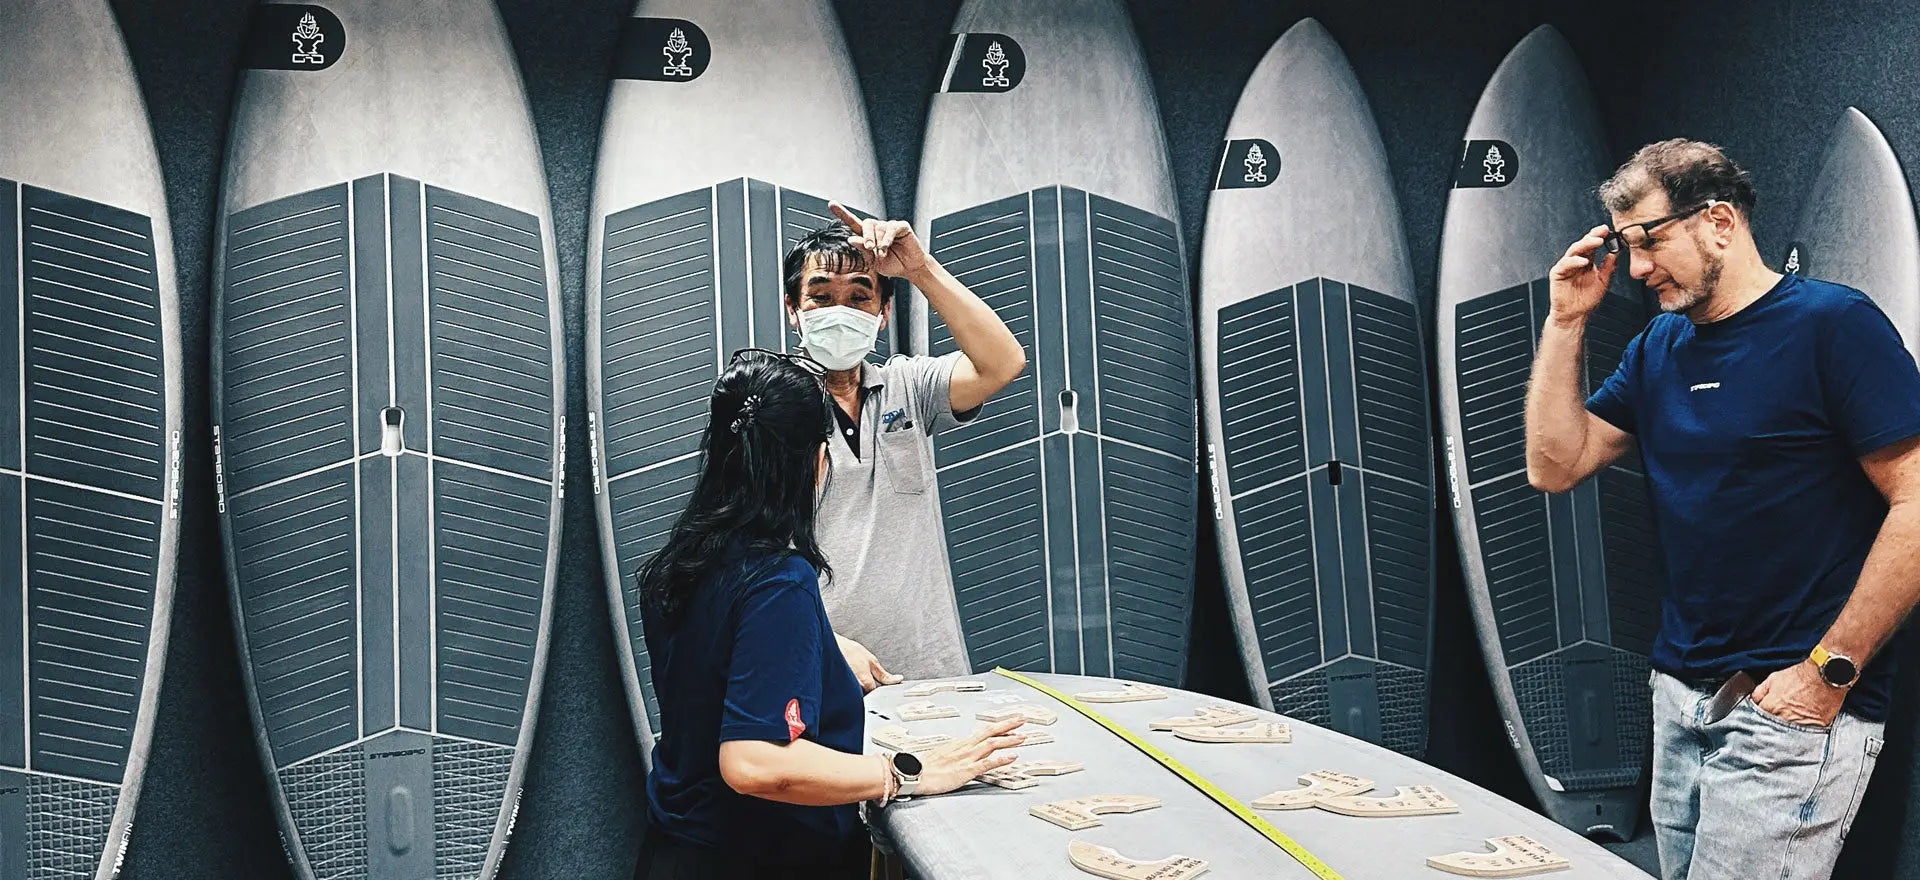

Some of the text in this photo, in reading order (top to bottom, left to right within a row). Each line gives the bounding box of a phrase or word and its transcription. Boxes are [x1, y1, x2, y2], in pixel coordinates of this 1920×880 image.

[170, 430, 180, 519] STARBOARD
[213, 425, 225, 513] STARBOARD
[558, 415, 566, 499] STARBOARD
[588, 411, 601, 495] STARBOARD
[1207, 443, 1223, 520] STARBOARD
[1446, 436, 1461, 509] STARBOARD
[369, 748, 426, 760] STARBOARD
[112, 822, 134, 874] TWINFIN
